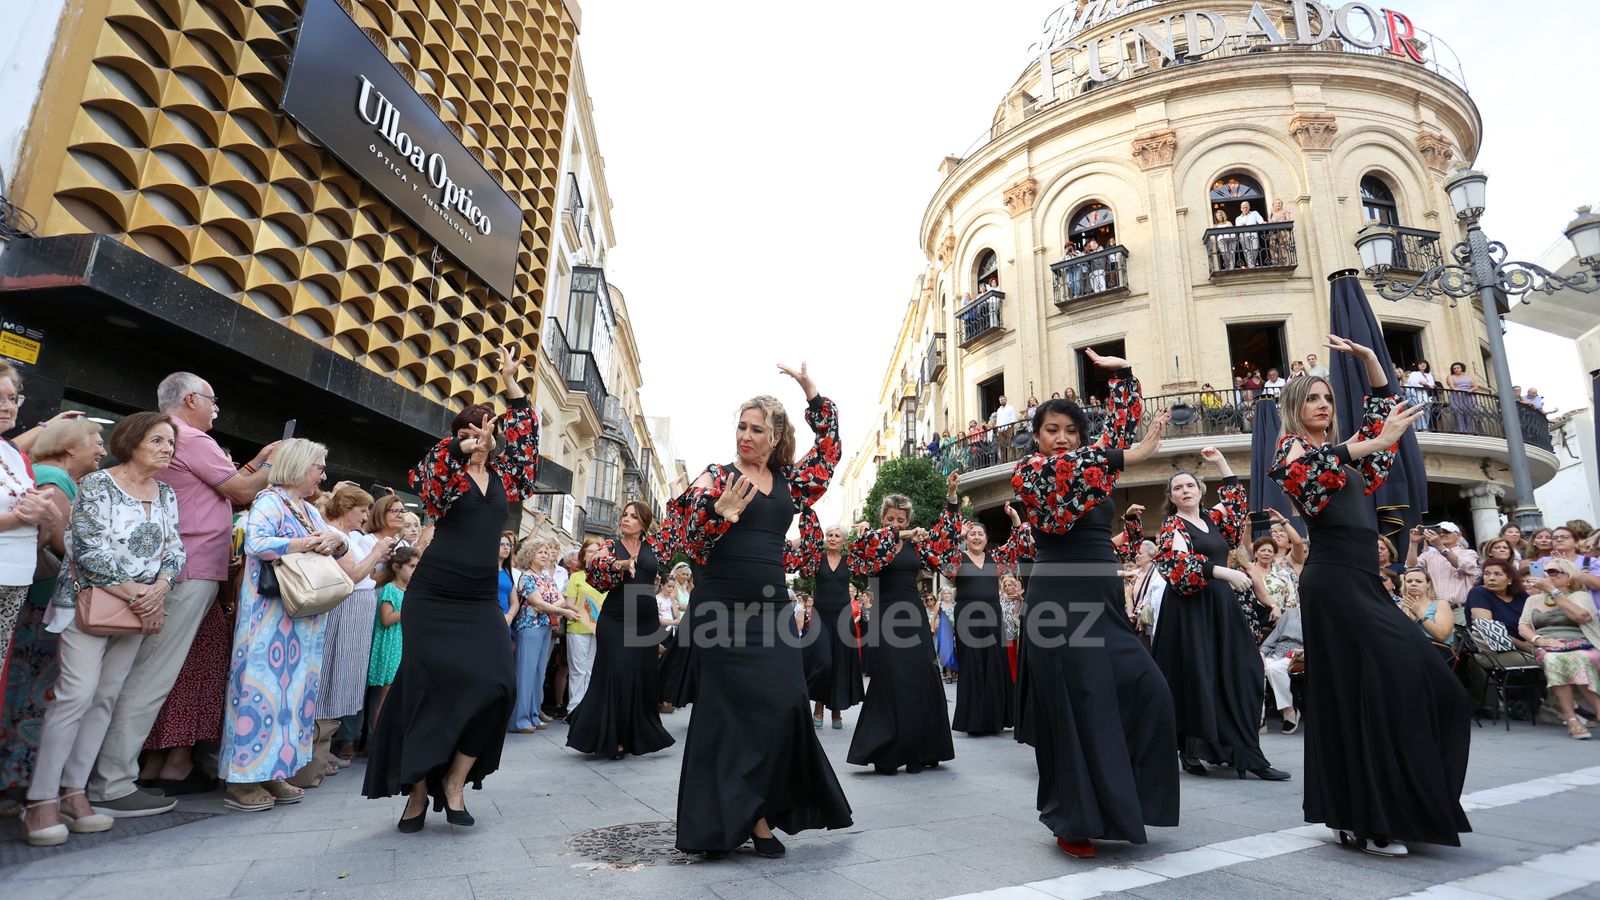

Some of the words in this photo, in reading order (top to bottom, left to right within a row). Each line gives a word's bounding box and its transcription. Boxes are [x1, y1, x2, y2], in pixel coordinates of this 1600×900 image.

[1038, 0, 1428, 105] FUNDADOR
[358, 75, 425, 173] Ulloa
[428, 153, 491, 235] Optico
[411, 183, 419, 191] Y
